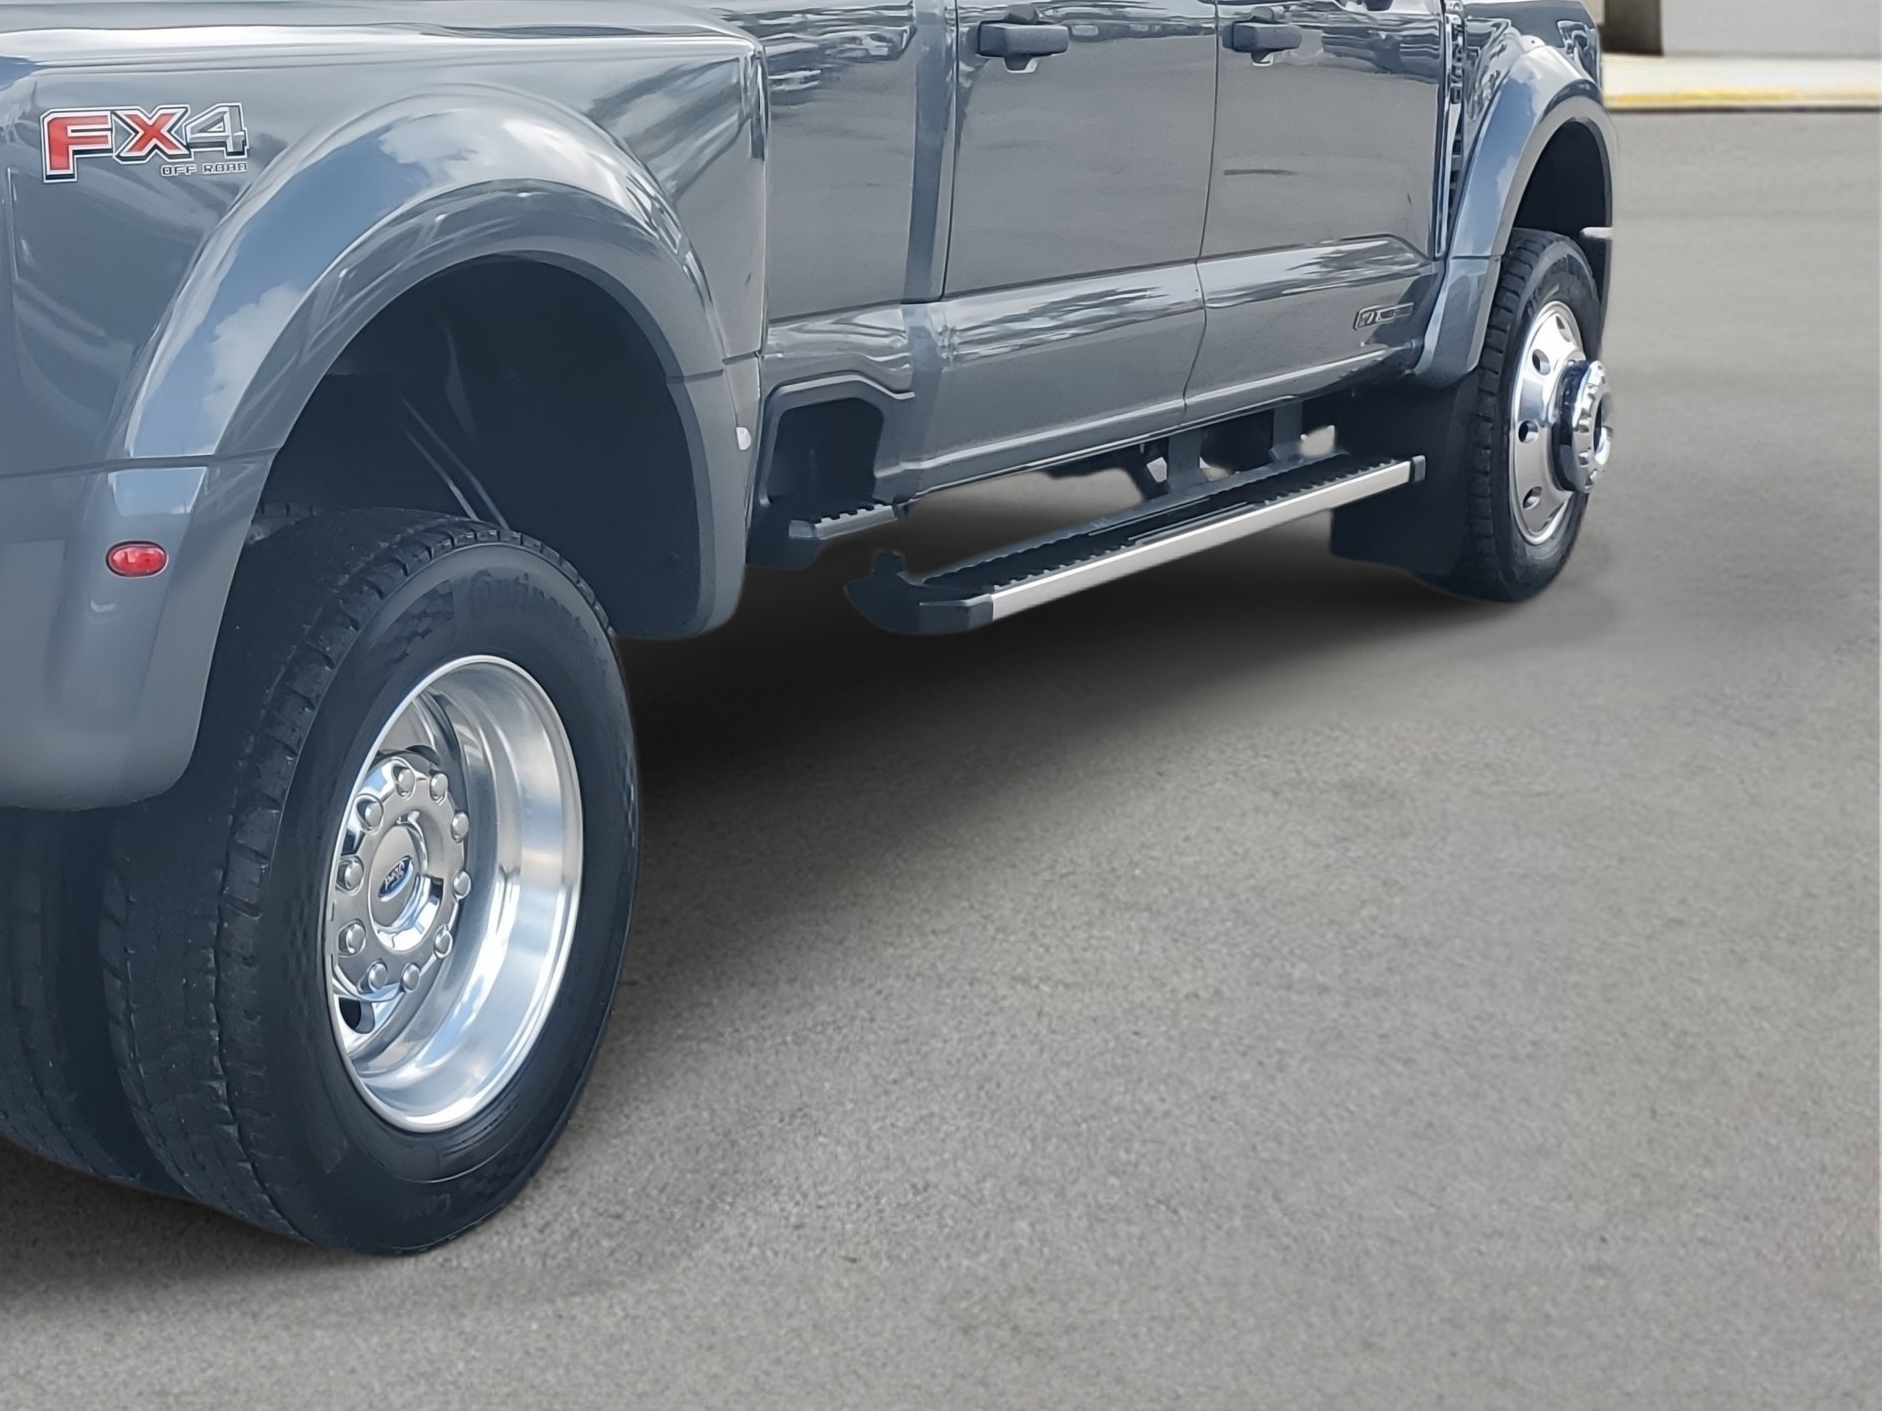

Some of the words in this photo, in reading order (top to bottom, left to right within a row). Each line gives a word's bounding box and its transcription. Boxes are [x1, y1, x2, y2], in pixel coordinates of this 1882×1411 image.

[40, 102, 250, 183] FX4
[161, 163, 197, 176] OFF
[203, 162, 247, 174] ROAD
